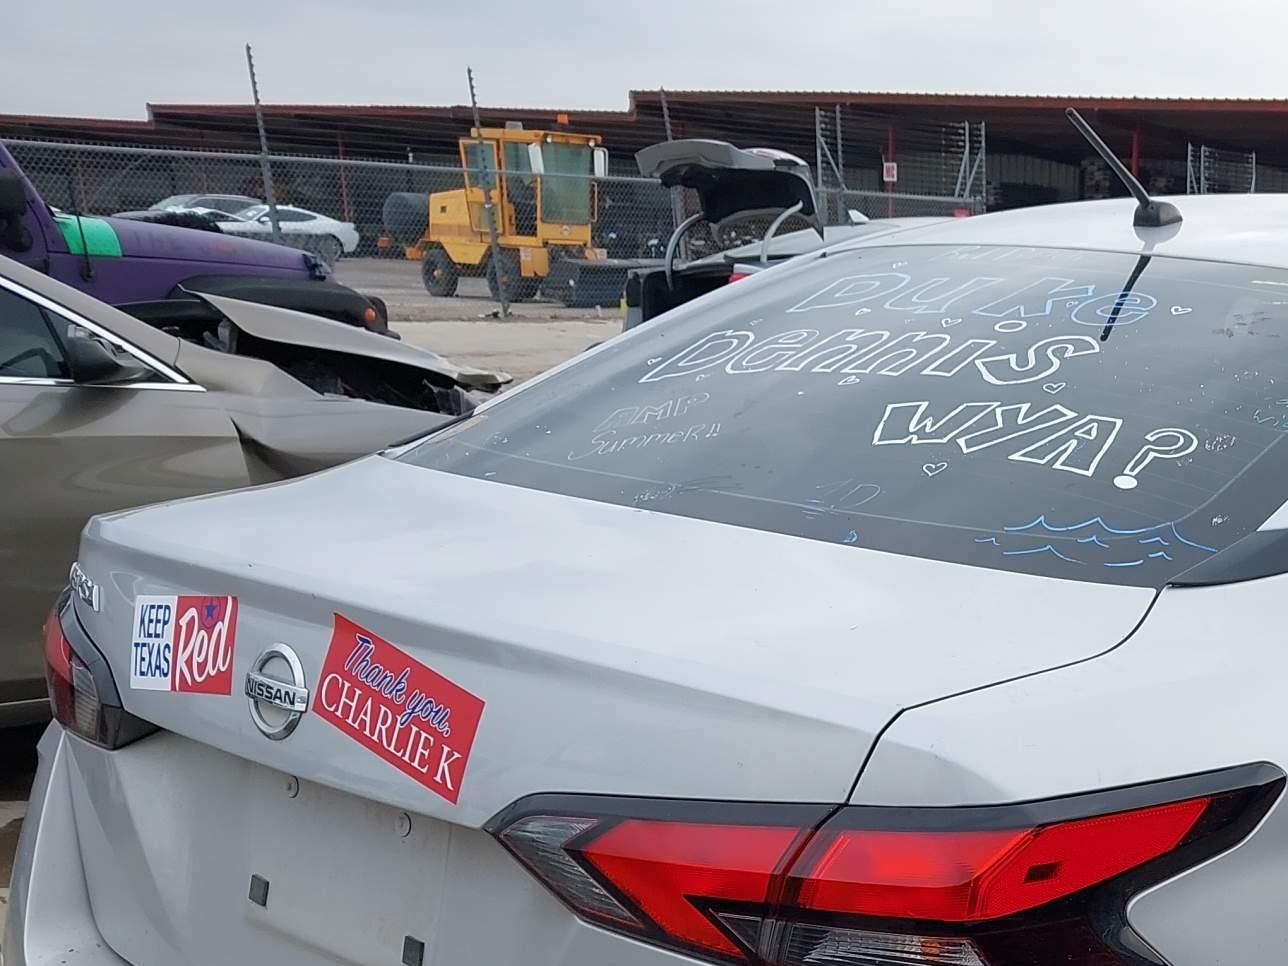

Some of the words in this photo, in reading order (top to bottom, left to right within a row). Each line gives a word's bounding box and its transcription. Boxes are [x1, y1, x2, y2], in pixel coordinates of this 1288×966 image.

[138, 604, 172, 639] KEEP
[175, 595, 234, 692] Red
[133, 643, 172, 678] TEXAS
[344, 633, 411, 704] Thank
[247, 677, 297, 706] NISSAN
[321, 672, 434, 774] CHARLIE
[433, 743, 463, 792] K
